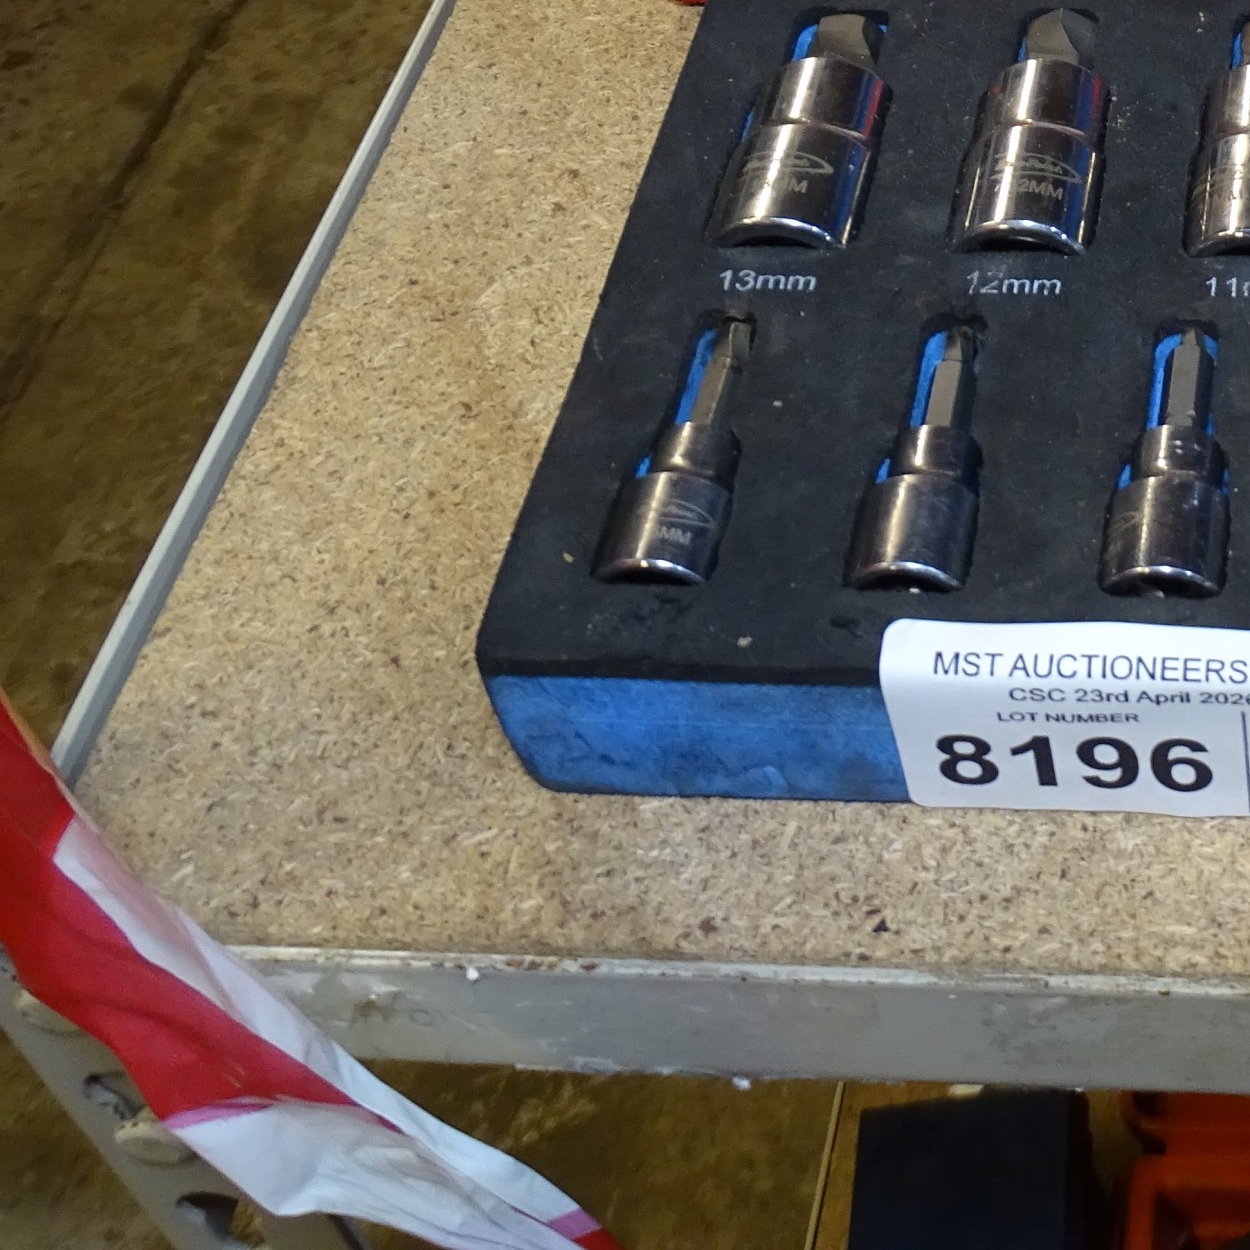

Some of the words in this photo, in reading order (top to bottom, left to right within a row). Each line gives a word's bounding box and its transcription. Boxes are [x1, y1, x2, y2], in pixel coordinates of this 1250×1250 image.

[719, 268, 817, 294] 13mm
[966, 269, 1062, 296] 12mm
[932, 650, 1003, 677] MST
[1009, 653, 1248, 685] AUCTIONEERS
[1008, 687, 1066, 703] CSC
[1075, 688, 1130, 705] 23rd
[1135, 690, 1192, 708] April
[996, 711, 1039, 723] LOT
[1045, 712, 1140, 725] NUMBER
[936, 733, 1214, 794] 8196
